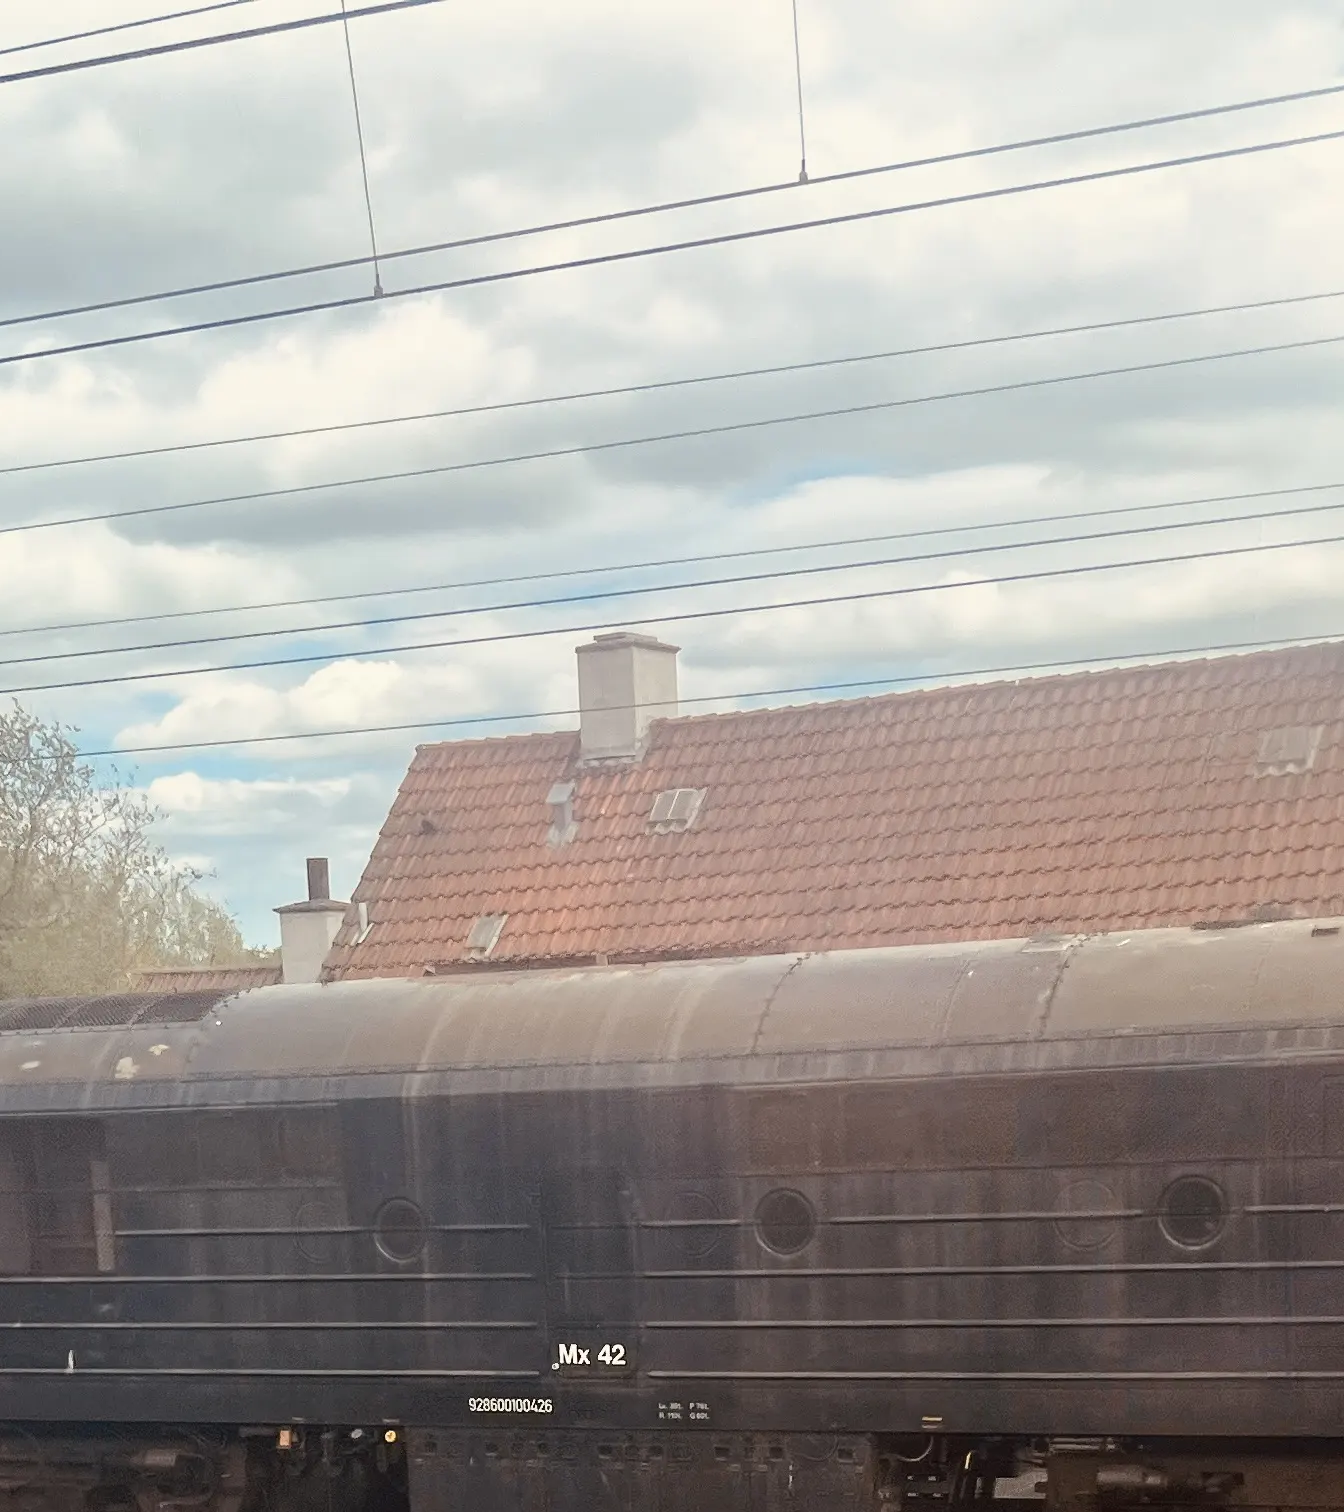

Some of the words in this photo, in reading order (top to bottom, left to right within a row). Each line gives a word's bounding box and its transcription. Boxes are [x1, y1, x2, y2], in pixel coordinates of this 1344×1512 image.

[558, 1343, 591, 1366] Mx
[597, 1343, 627, 1366] 42
[468, 1398, 553, 1414] 928600100426
